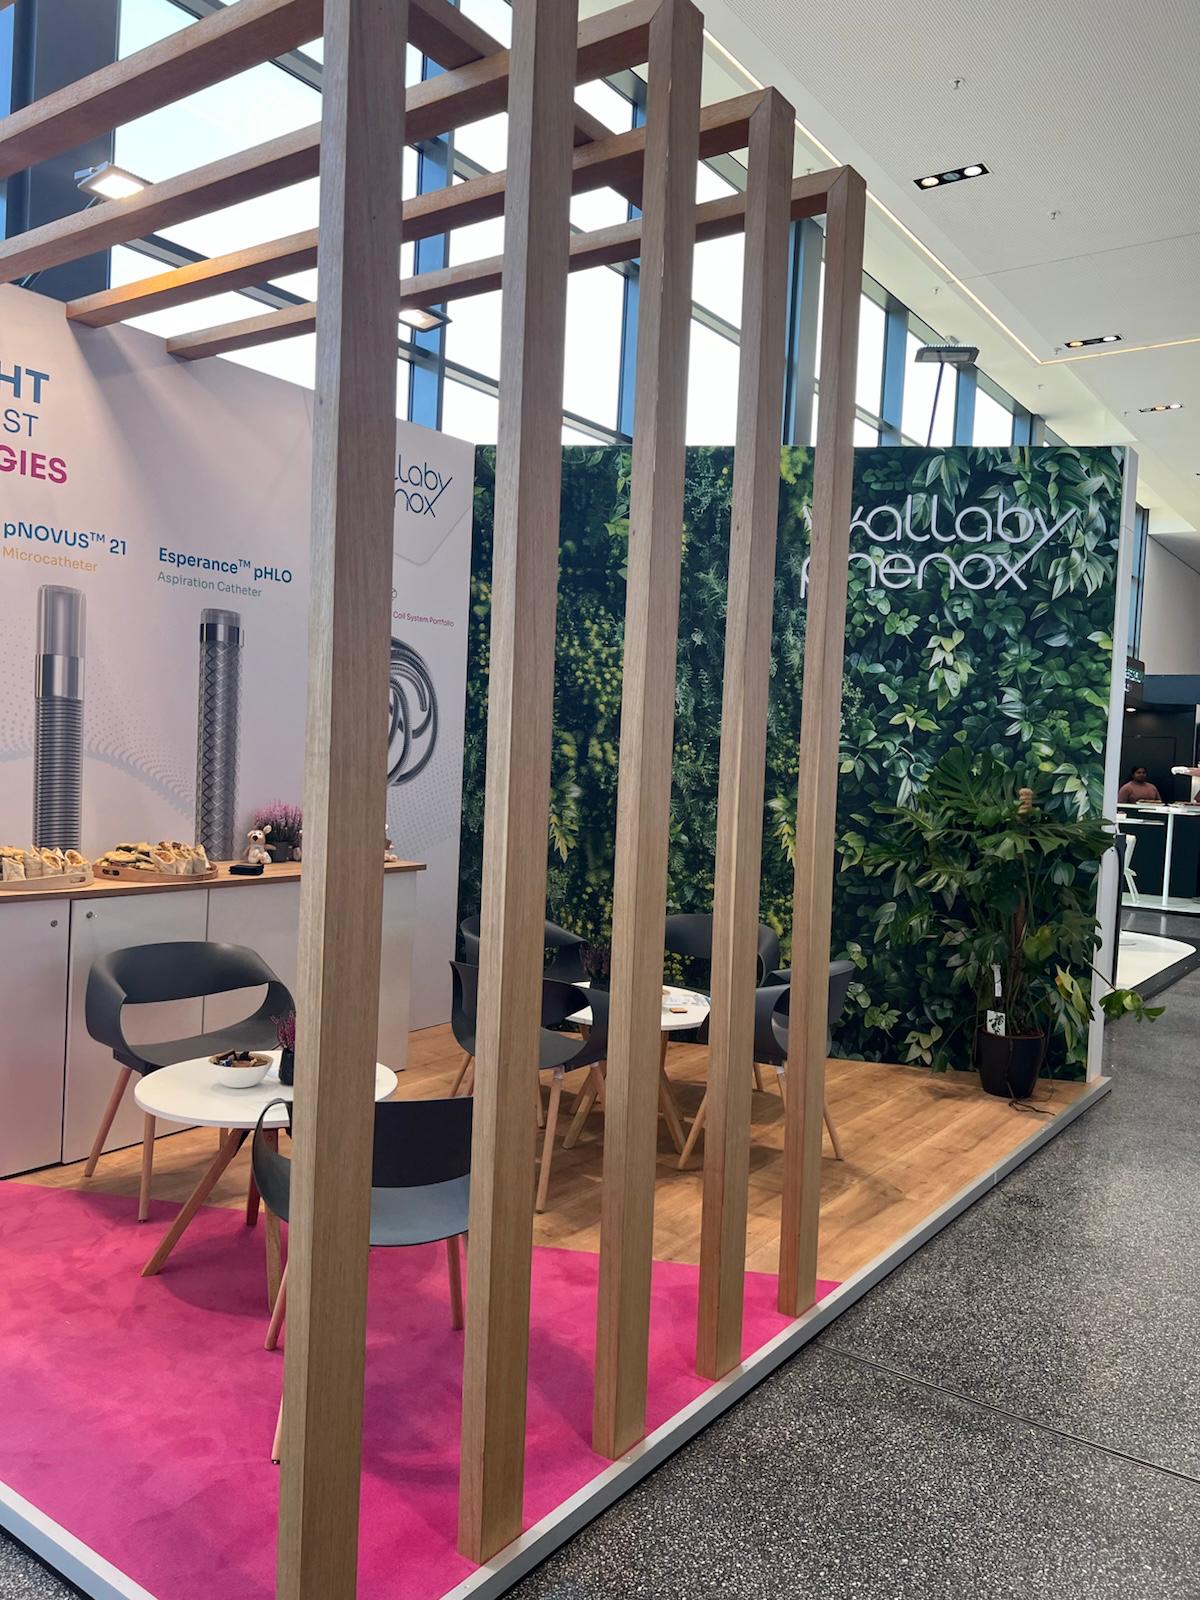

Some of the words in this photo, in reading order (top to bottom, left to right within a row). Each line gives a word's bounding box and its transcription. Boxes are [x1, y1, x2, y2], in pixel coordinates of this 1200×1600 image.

[3, 408, 39, 437] ST
[0, 444, 68, 484] GIES
[394, 454, 453, 494] laby
[2, 546, 98, 573] Microcatheter
[109, 538, 127, 556] 21
[157, 570, 215, 591] Aspiration
[216, 580, 262, 598] Catheter
[253, 565, 293, 584] pHLO
[406, 613, 429, 623] System
[429, 616, 455, 628] Portfolio
